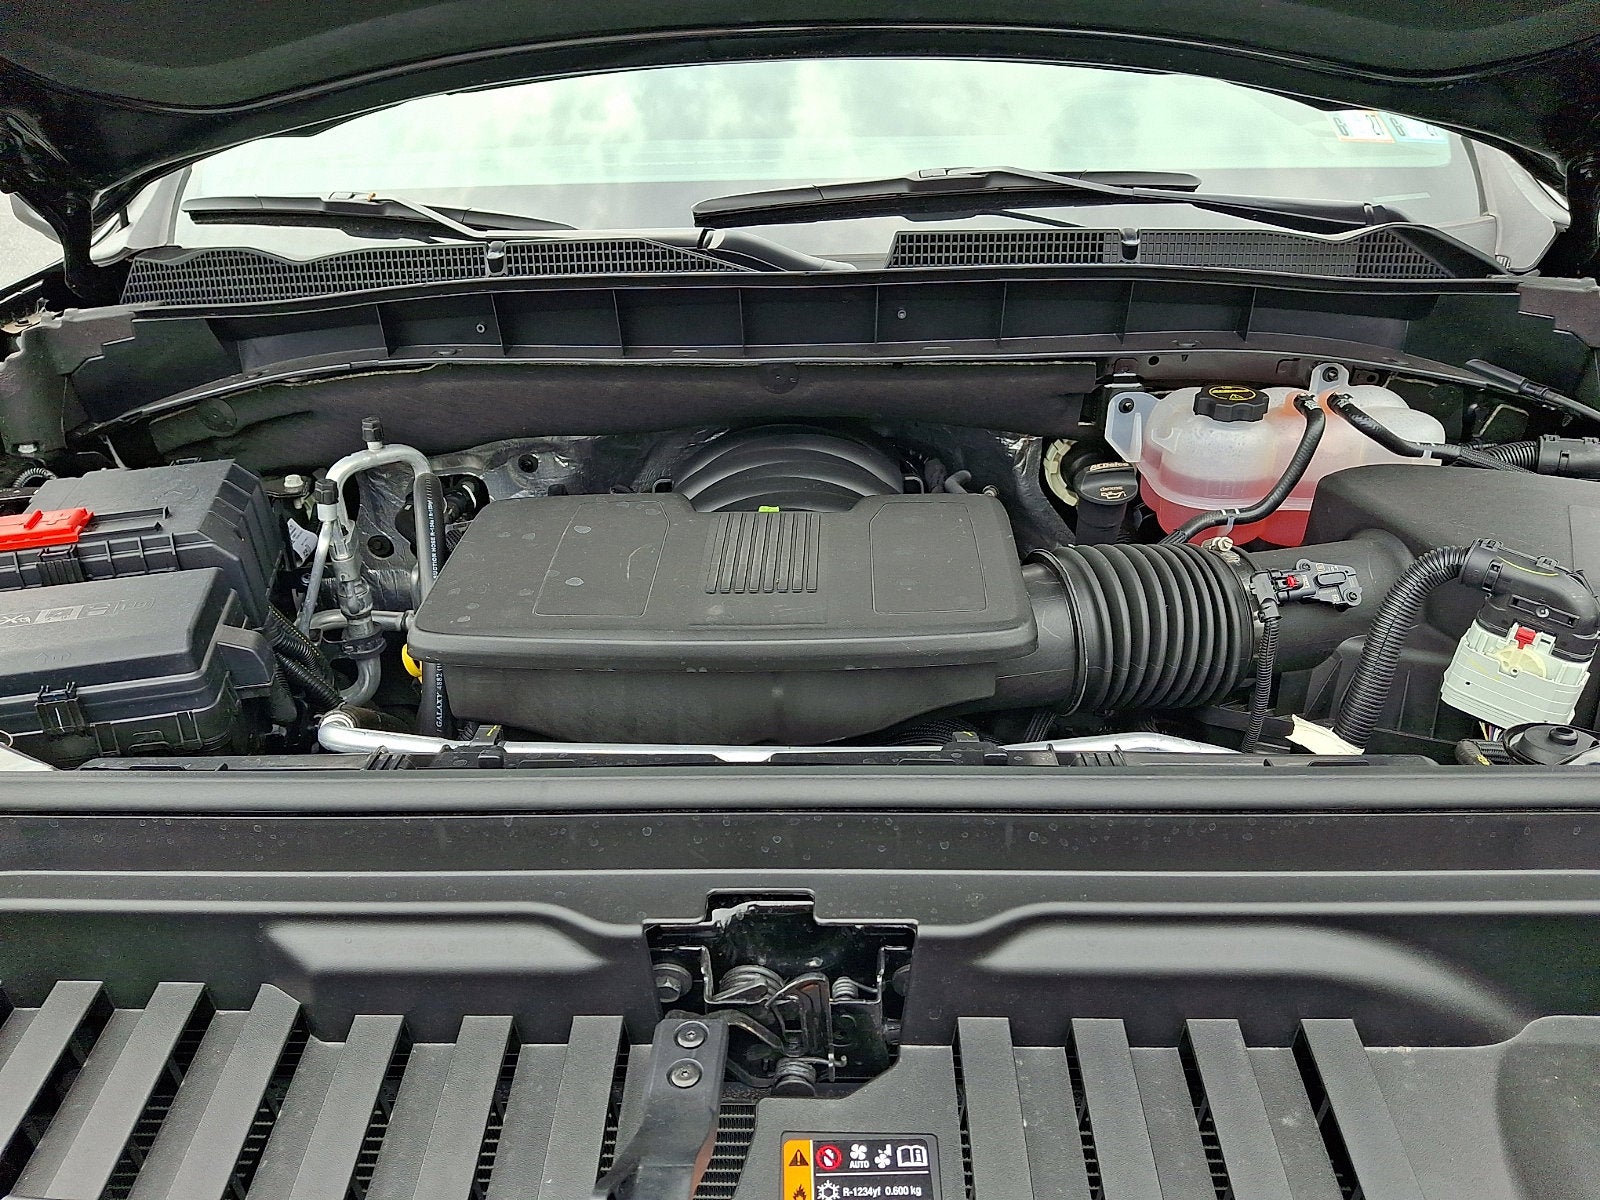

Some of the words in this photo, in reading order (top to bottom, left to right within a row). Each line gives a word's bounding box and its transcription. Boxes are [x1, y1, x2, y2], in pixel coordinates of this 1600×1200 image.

[849, 1160, 870, 1169] AUTO
[842, 1187, 881, 1198] R-1234yf
[885, 1186, 909, 1196] 0.600
[911, 1186, 922, 1196] kg
